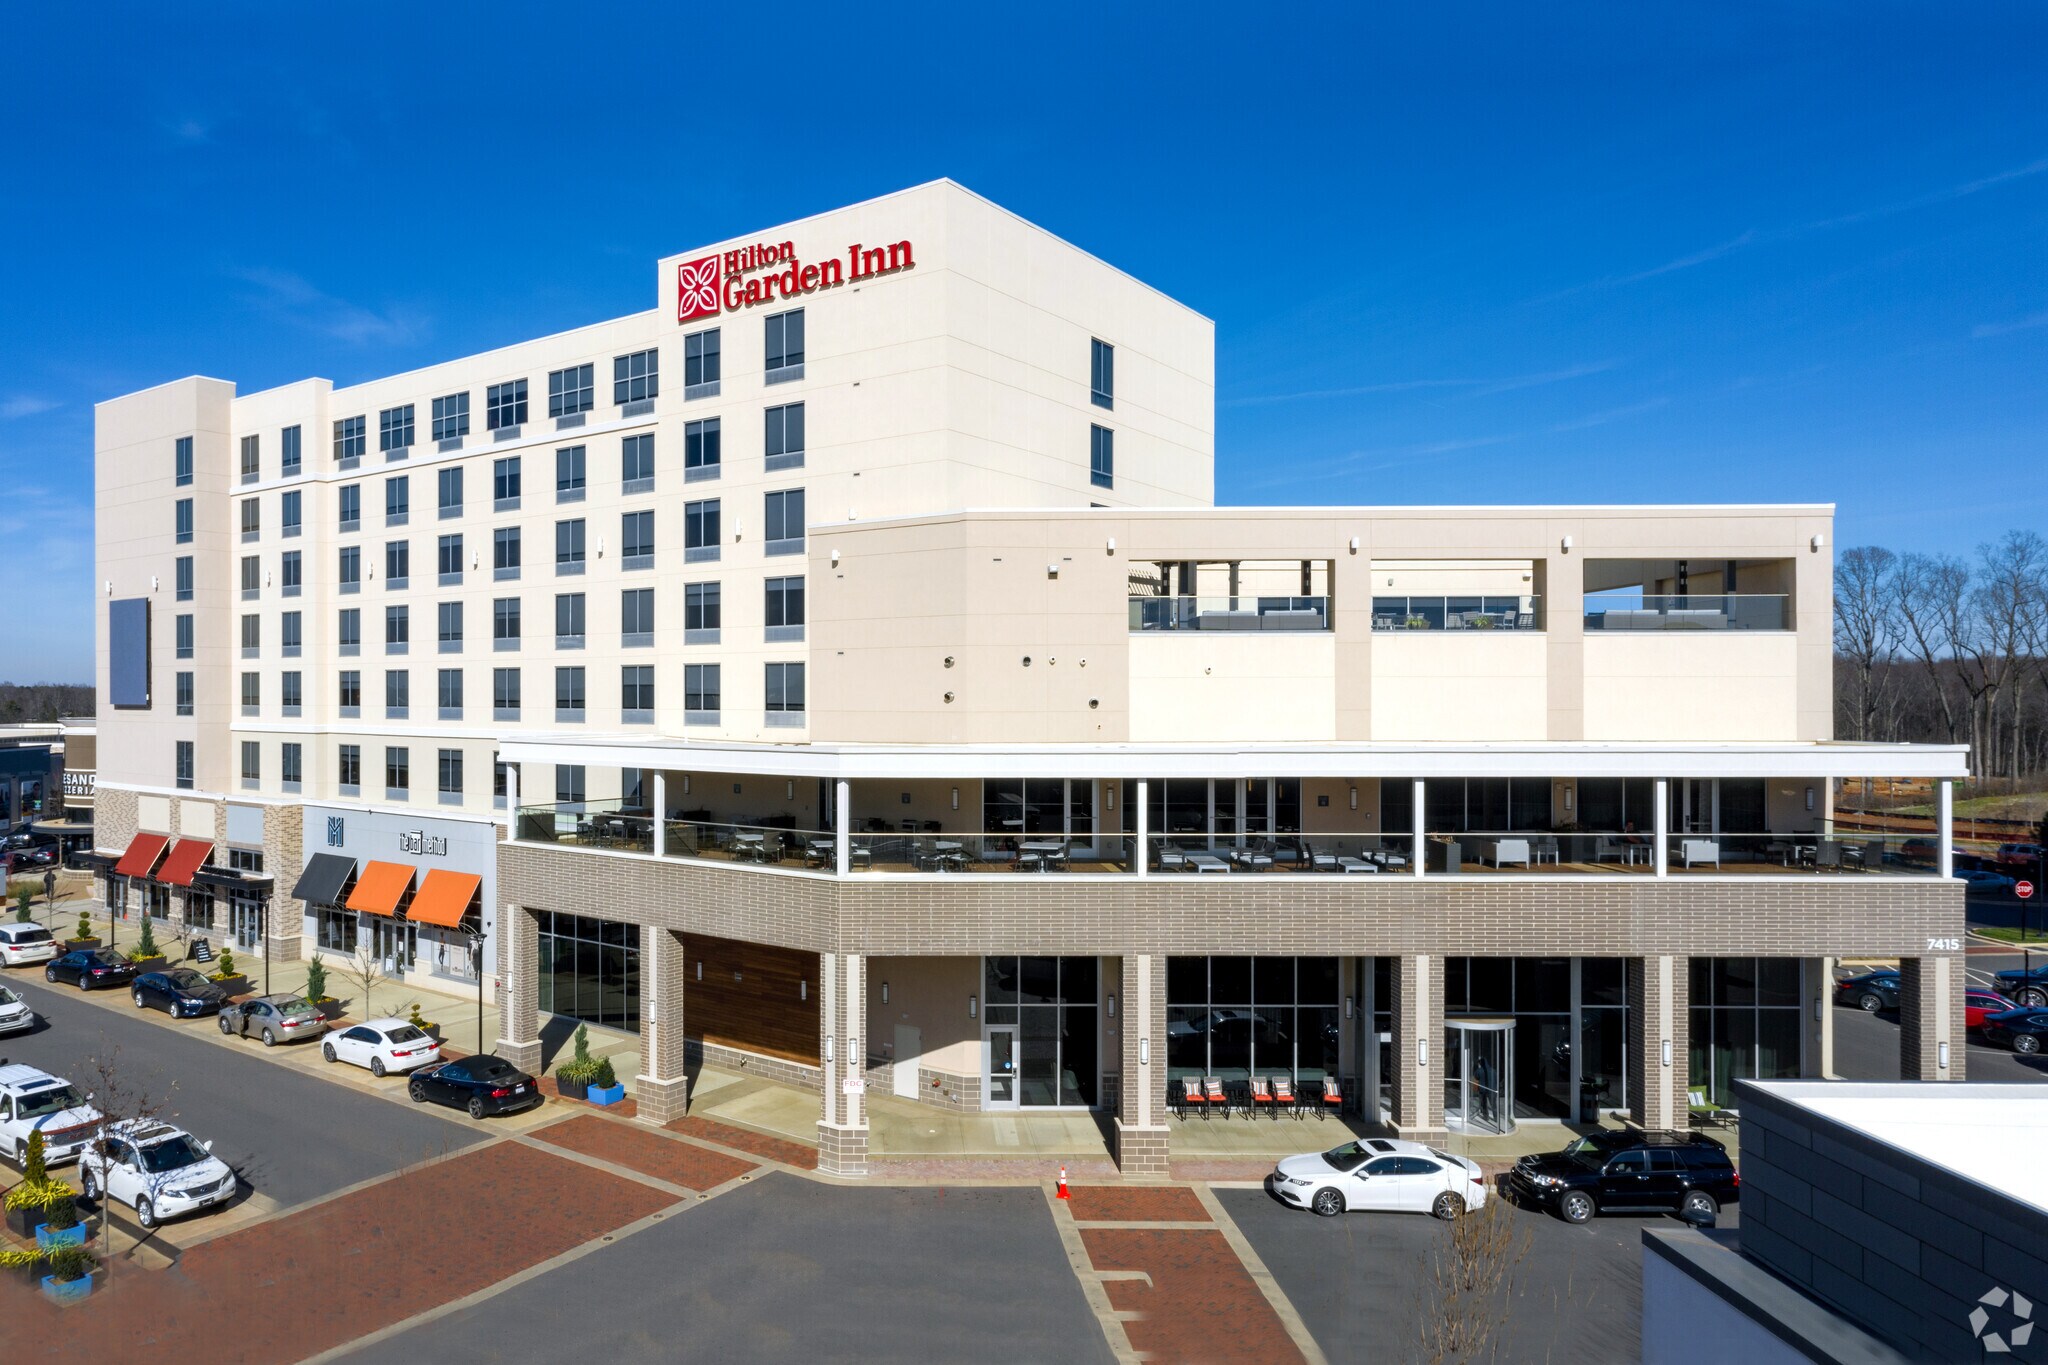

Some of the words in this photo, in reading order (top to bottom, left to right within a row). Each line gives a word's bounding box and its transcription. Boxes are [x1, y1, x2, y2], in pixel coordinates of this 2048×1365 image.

[723, 240, 796, 276] Hilton
[723, 259, 844, 310] Garden
[848, 239, 915, 284] Inn
[410, 831, 422, 854] bar
[422, 836, 447, 856] method
[1926, 938, 1960, 950] 7415
